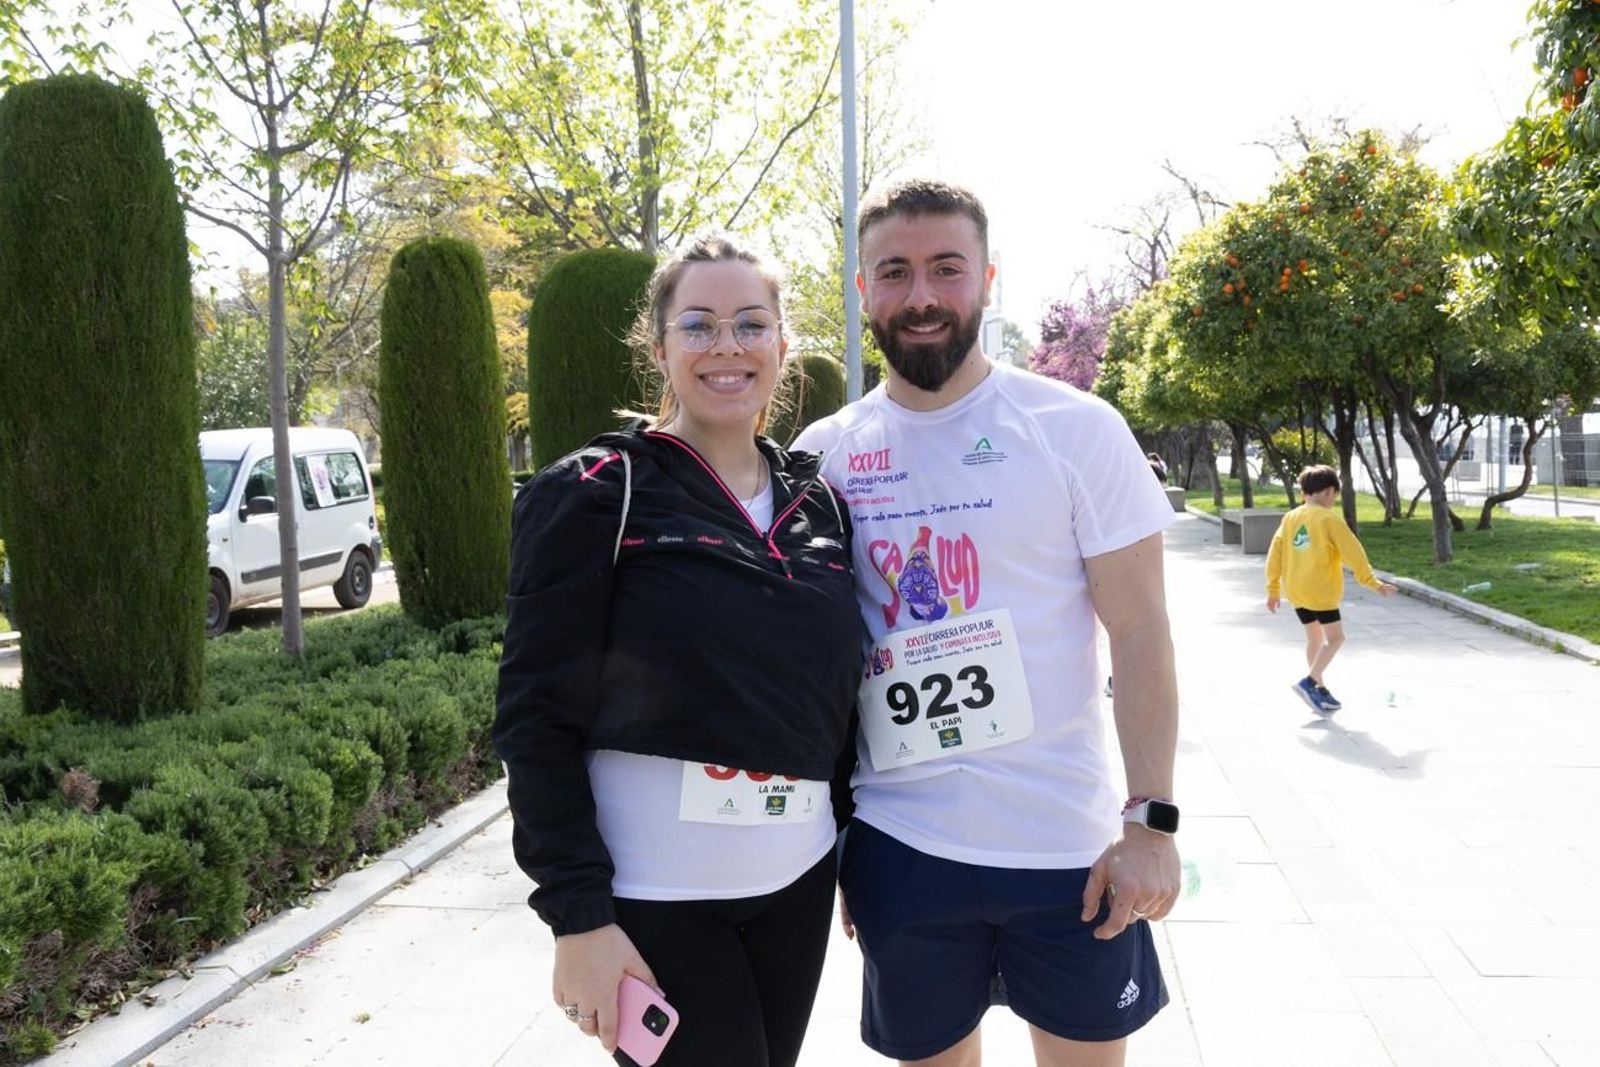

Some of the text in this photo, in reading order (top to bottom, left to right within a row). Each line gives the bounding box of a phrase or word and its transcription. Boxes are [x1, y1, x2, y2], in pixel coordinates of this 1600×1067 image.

[848, 448, 891, 473] XXVII
[874, 471, 908, 484] POPULAR
[973, 498, 992, 508] salud
[928, 627, 959, 642] CARRERA
[959, 619, 994, 635] POPULAR
[904, 650, 915, 658] POR
[886, 665, 995, 726] 923
[942, 717, 962, 727] PAPI
[758, 784, 795, 794] LA MAMI
